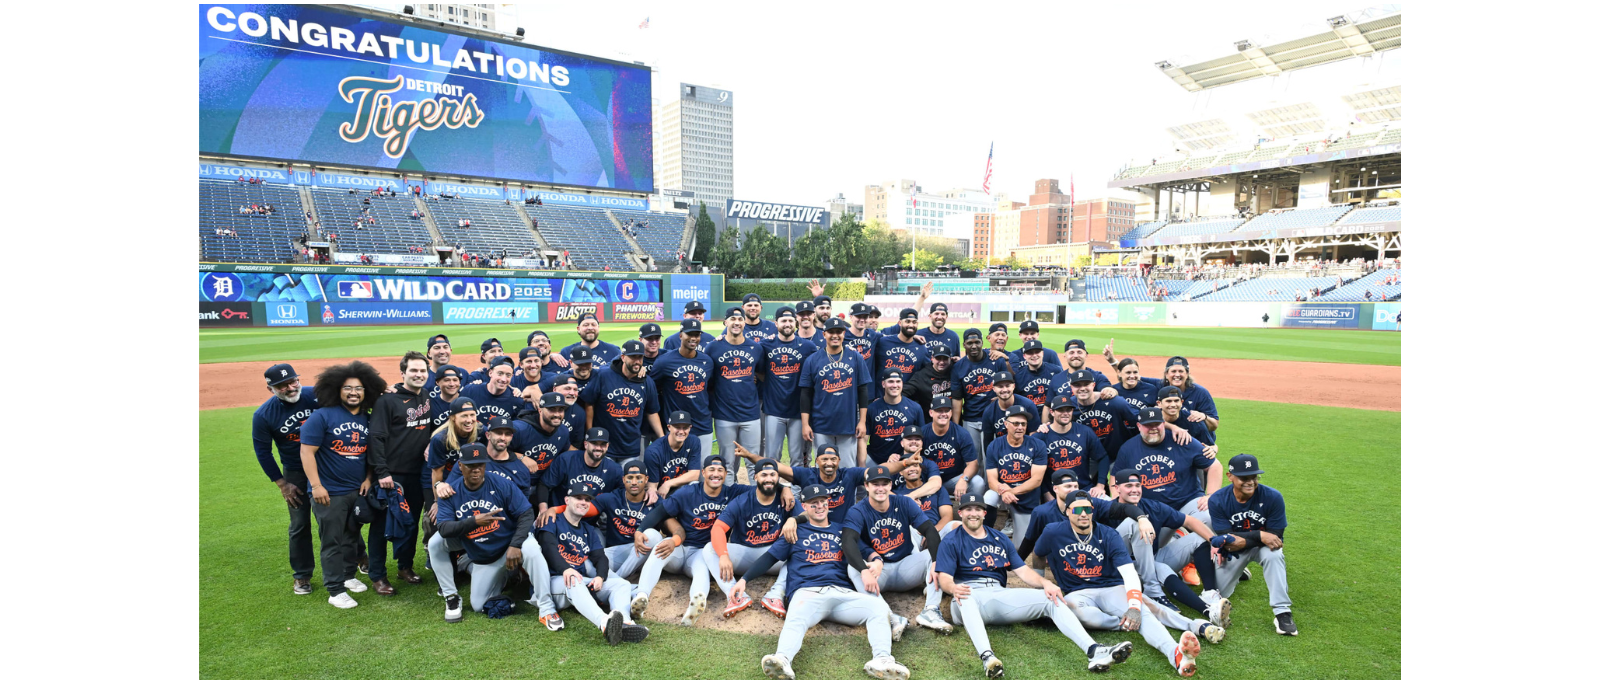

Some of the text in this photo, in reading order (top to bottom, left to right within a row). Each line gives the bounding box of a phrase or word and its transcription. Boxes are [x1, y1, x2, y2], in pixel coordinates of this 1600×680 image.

[207, 6, 570, 86] CONGRATULATIONS
[406, 78, 464, 97] DETROIT
[338, 74, 485, 158] Tigers
[213, 166, 286, 180] HONDA
[337, 176, 399, 188] HONDA
[446, 185, 500, 196] HONDA
[539, 192, 588, 204] HONDA
[601, 198, 644, 208] HONDA
[728, 201, 825, 224] PROGRESSIVE
[514, 288, 552, 296] 2025
[622, 282, 634, 300] C
[673, 286, 709, 300] meijer
[616, 304, 656, 312] PHANTOM
[718, 350, 754, 364] OCTOBER
[768, 347, 802, 360] OCTOBER
[781, 354, 788, 363] D
[886, 347, 917, 363] OCTOBER
[733, 357, 741, 366] D
[770, 362, 800, 375] Baseball
[672, 365, 707, 379] OCTOBER
[720, 366, 752, 379] Baseball
[819, 362, 854, 377] OCTOBER
[833, 370, 841, 379] D
[688, 373, 695, 382] D
[674, 381, 705, 394] Baseball
[821, 378, 852, 392] Baseball
[1024, 379, 1051, 393] OCTOBE
[607, 388, 643, 405] OCTOBER
[606, 402, 640, 417] Baseball
[280, 409, 313, 433] OCTOB
[875, 410, 908, 424] OCTOBER
[1076, 410, 1112, 424] OCTOBER
[333, 422, 369, 436] OCTOBE
[875, 425, 905, 438] Baseball
[525, 443, 557, 457] OCTOBER
[1046, 440, 1083, 454] OCTOBER
[1049, 456, 1082, 471] Baseball
[1135, 454, 1175, 471] OCTOBER
[1151, 464, 1160, 476] D
[1140, 471, 1176, 488] Baseball
[821, 541, 830, 551] D
[805, 550, 843, 564] Baseball
[1059, 544, 1104, 563] OCTOBER
[1077, 554, 1086, 565] D
